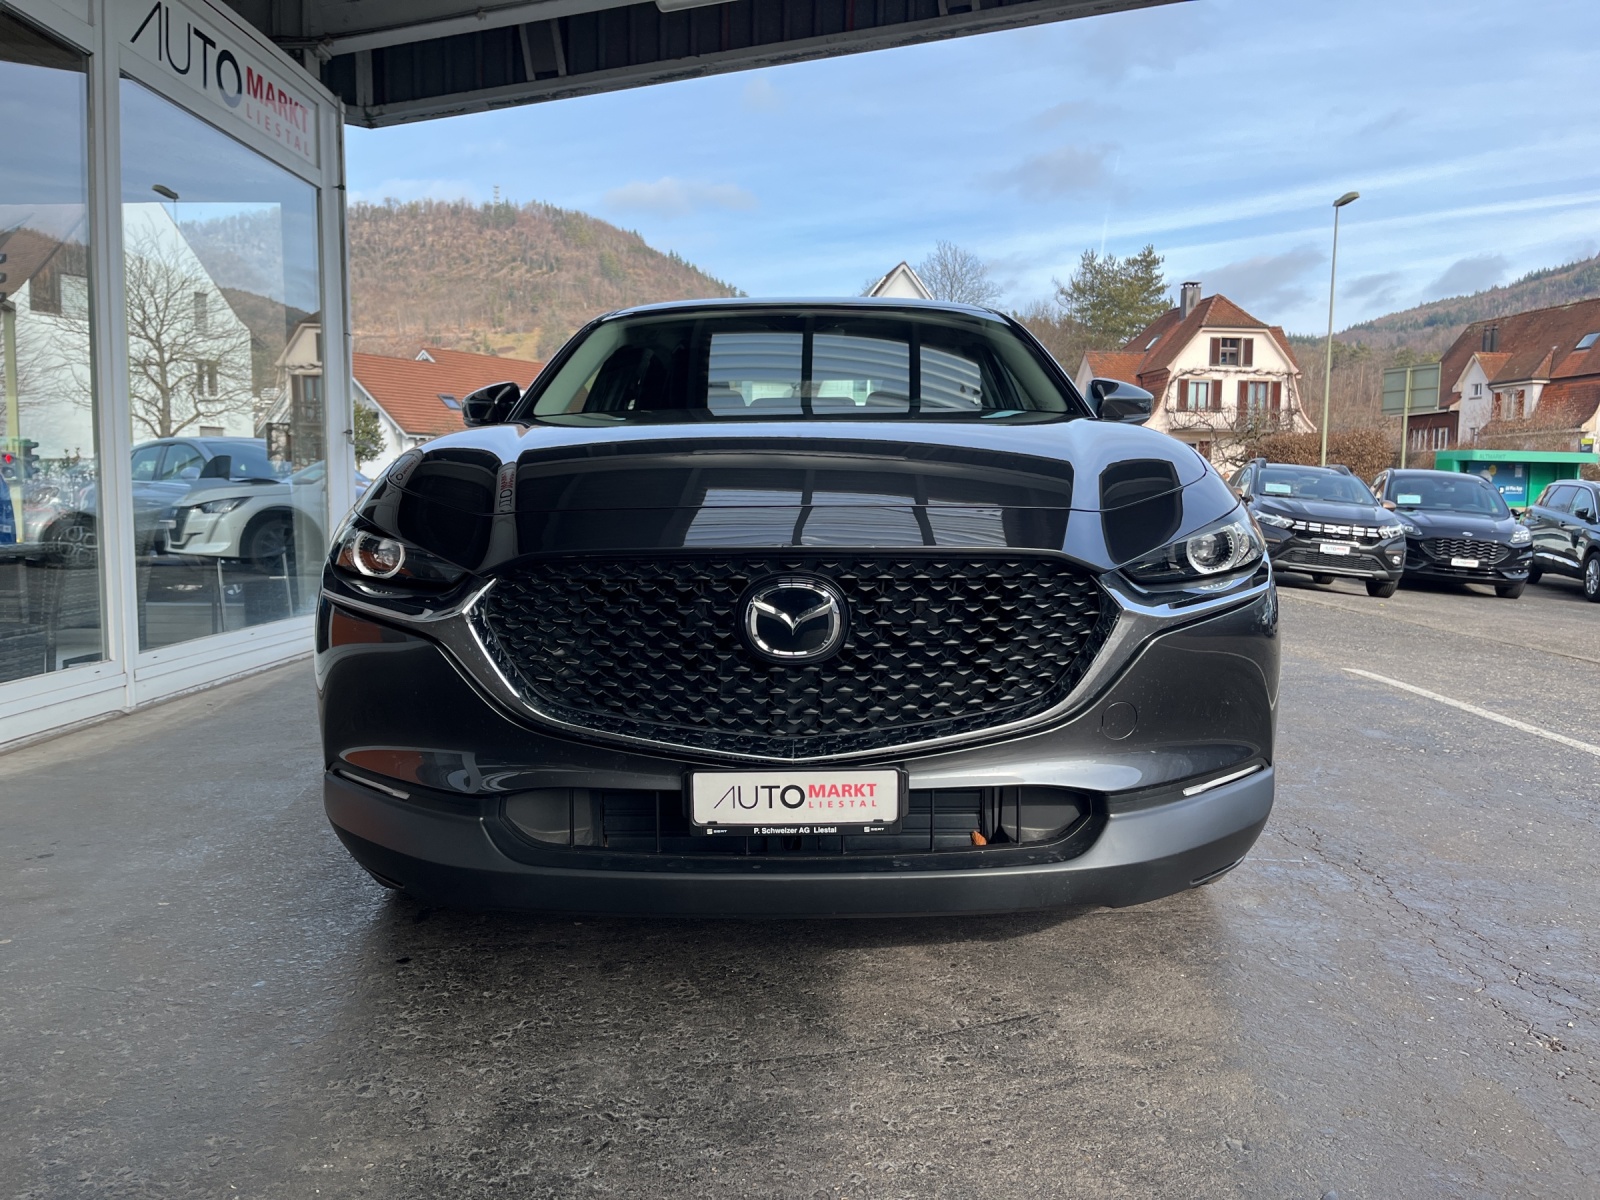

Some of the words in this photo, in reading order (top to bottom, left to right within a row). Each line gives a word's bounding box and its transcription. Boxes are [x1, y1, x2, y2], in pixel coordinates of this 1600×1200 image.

[130, 1, 243, 108] AUTO
[246, 66, 309, 134] MARKT
[246, 103, 310, 156] LIESTAL
[713, 784, 806, 810] AUTO
[808, 783, 877, 798] MARKT
[808, 800, 877, 809] LIESTAL
[753, 827, 761, 835] P.
[798, 826, 811, 834] AG
[813, 826, 837, 834] Liestal
